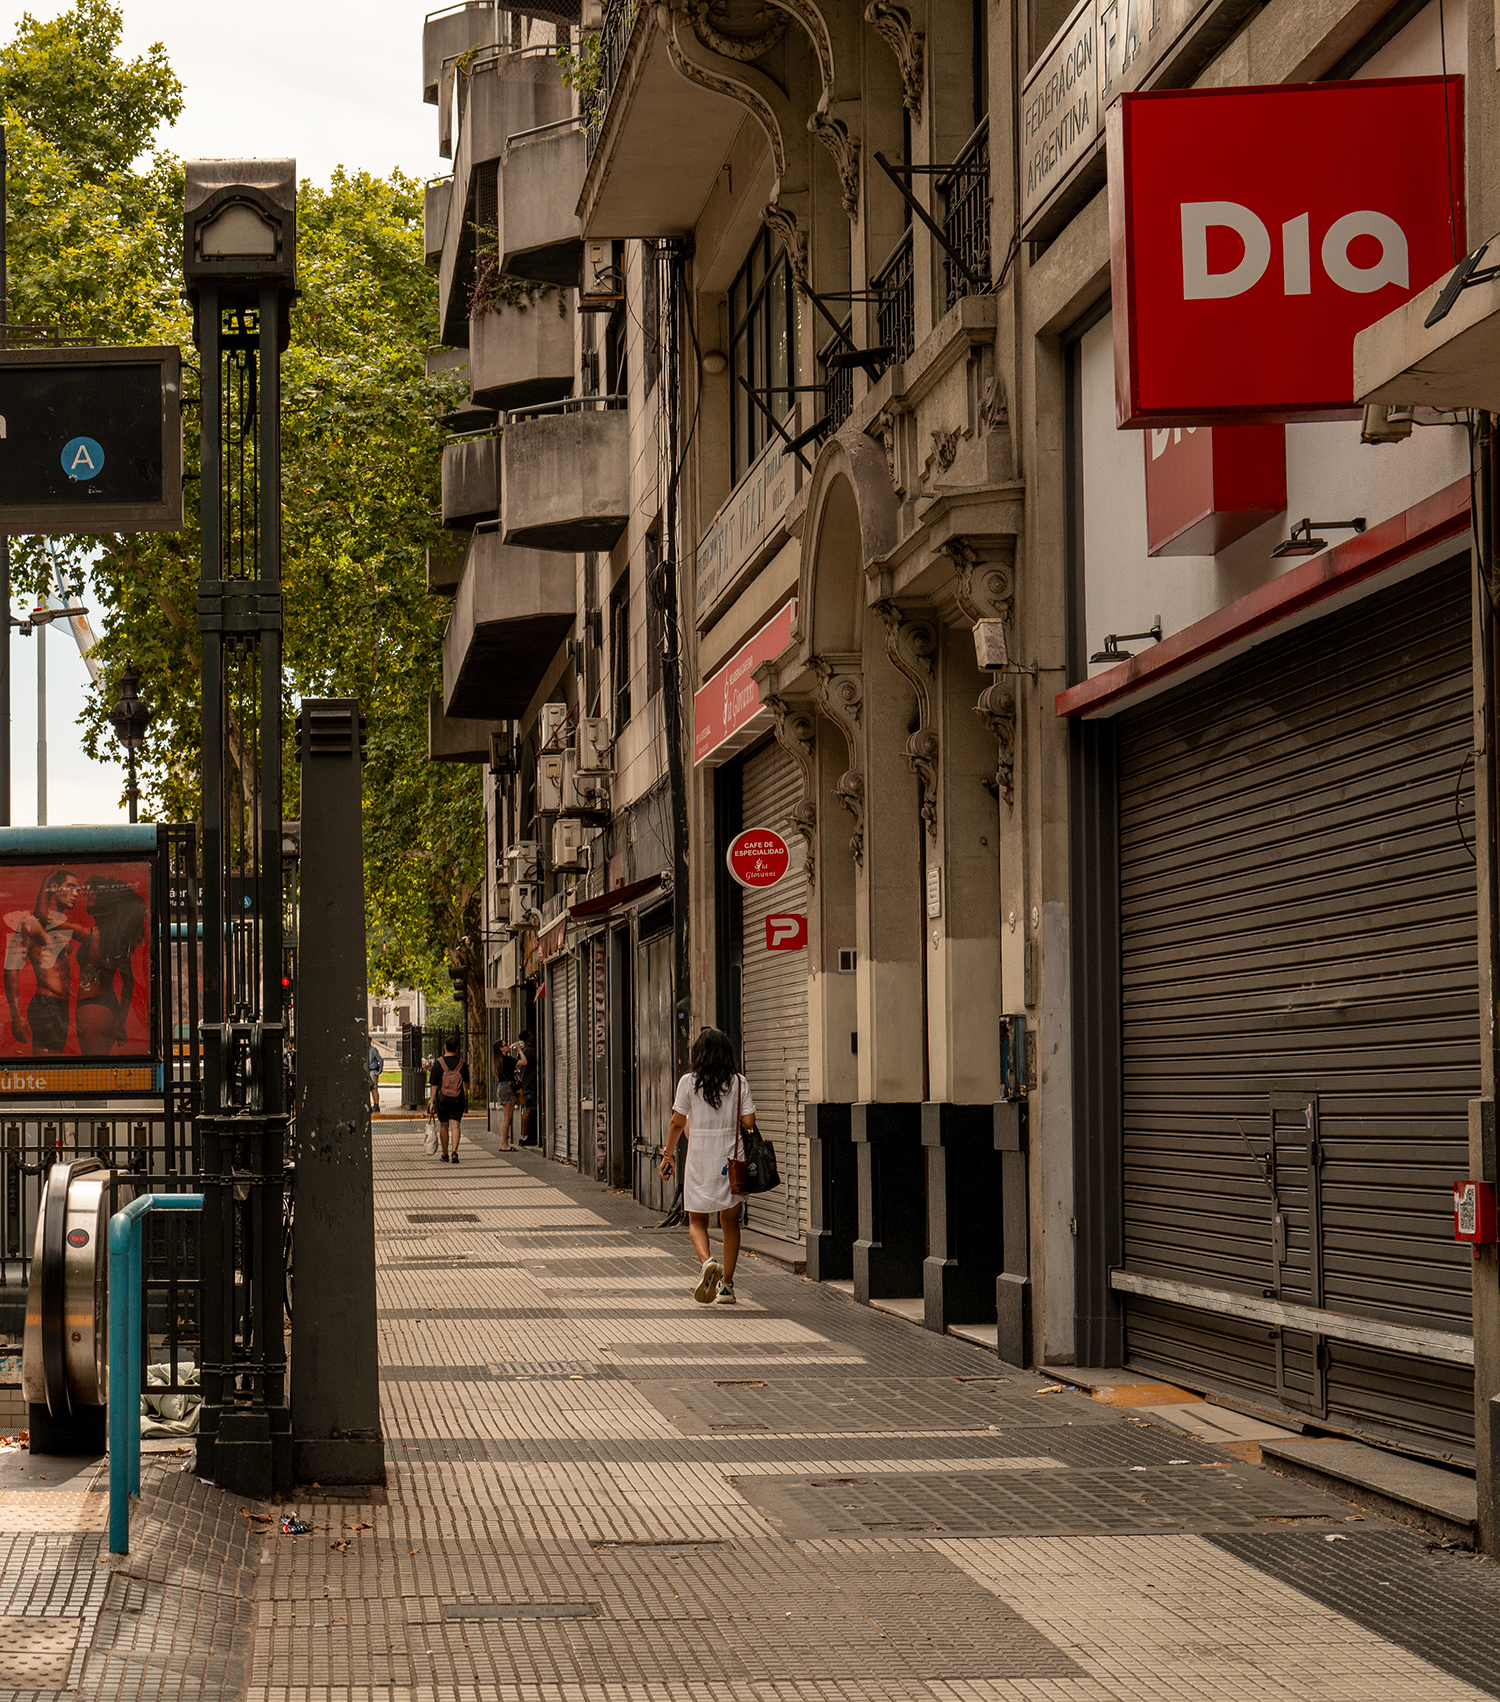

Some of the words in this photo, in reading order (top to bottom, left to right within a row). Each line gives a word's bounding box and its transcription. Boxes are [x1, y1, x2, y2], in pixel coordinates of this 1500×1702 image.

[1025, 26, 1092, 146] FEDERACION
[1027, 91, 1090, 197] ARGENTINA
[70, 444, 95, 470] A
[718, 514, 735, 579] FAT
[734, 848, 785, 857] ESPECIALIDAD
[745, 871, 776, 880] Giovanni
